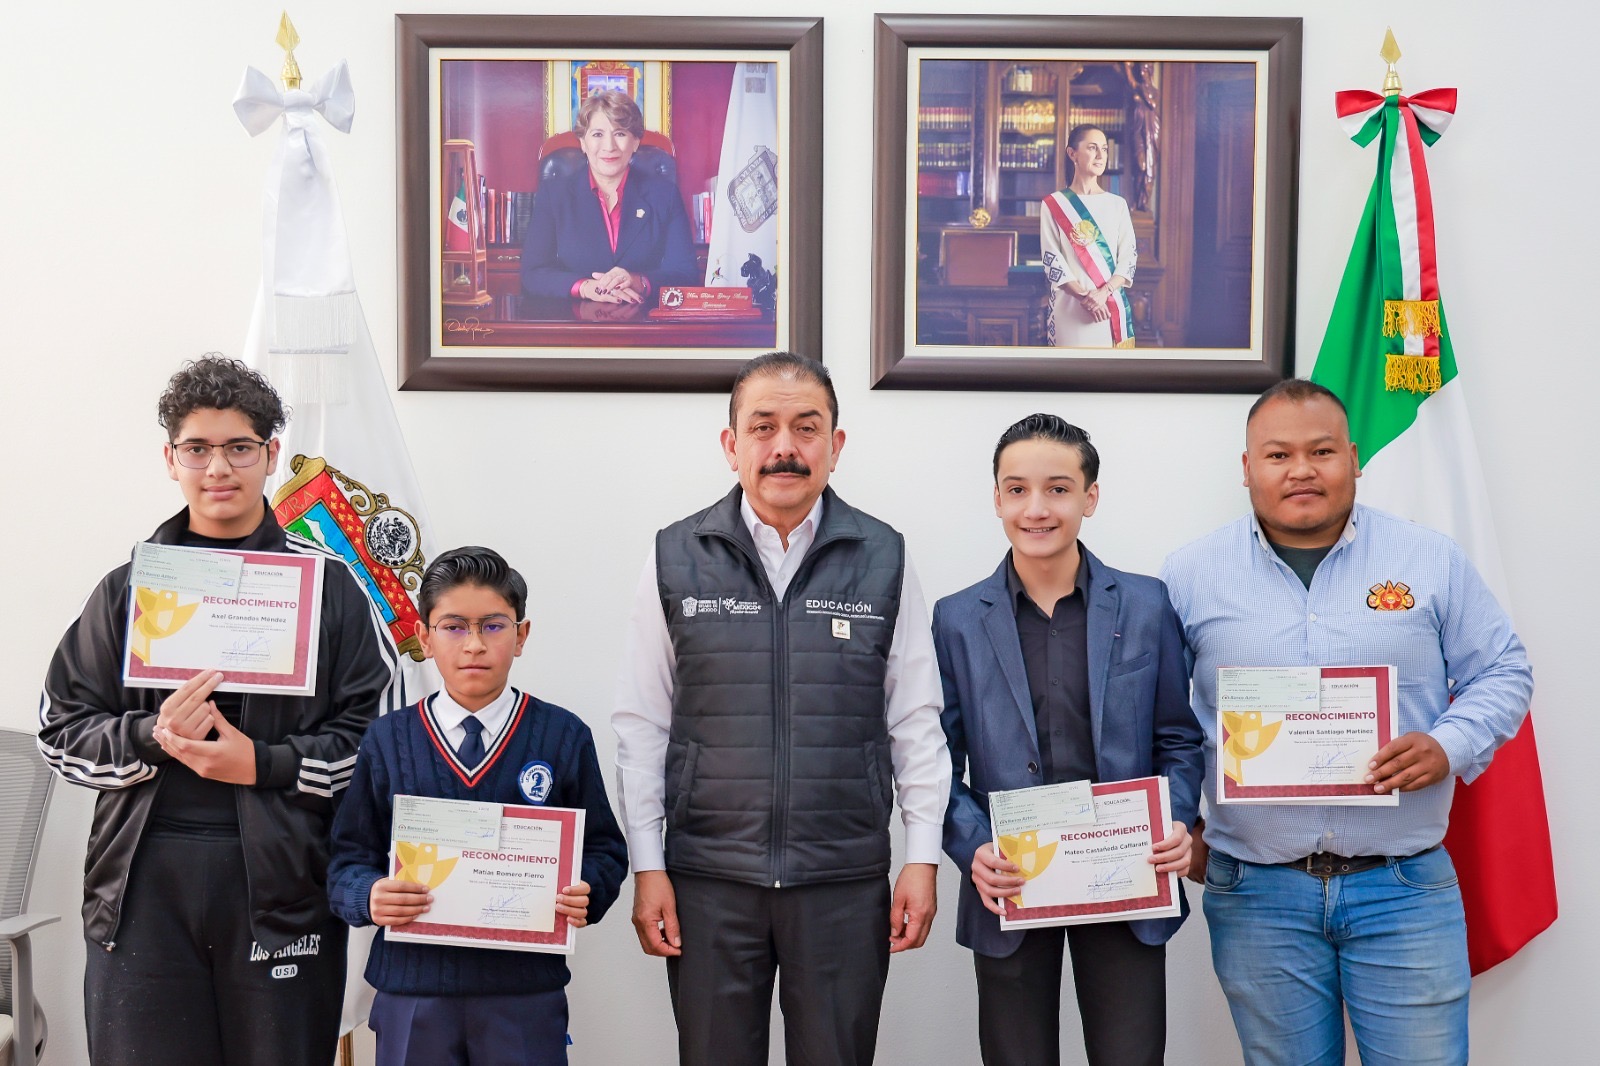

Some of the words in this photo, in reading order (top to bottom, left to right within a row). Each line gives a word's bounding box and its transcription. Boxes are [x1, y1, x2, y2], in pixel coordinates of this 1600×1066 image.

[202, 595, 297, 609] RECONOCIMIENTO
[806, 599, 872, 613] EDUCACIÓN
[1285, 711, 1376, 721] RECONOCIMIENTO
[1060, 824, 1149, 842] RECONOCIMIENTO
[1085, 845, 1118, 854] Castañeda
[461, 850, 558, 865] RECONOCIMIENTO
[496, 870, 522, 878] Romero
[275, 967, 296, 977] USA
